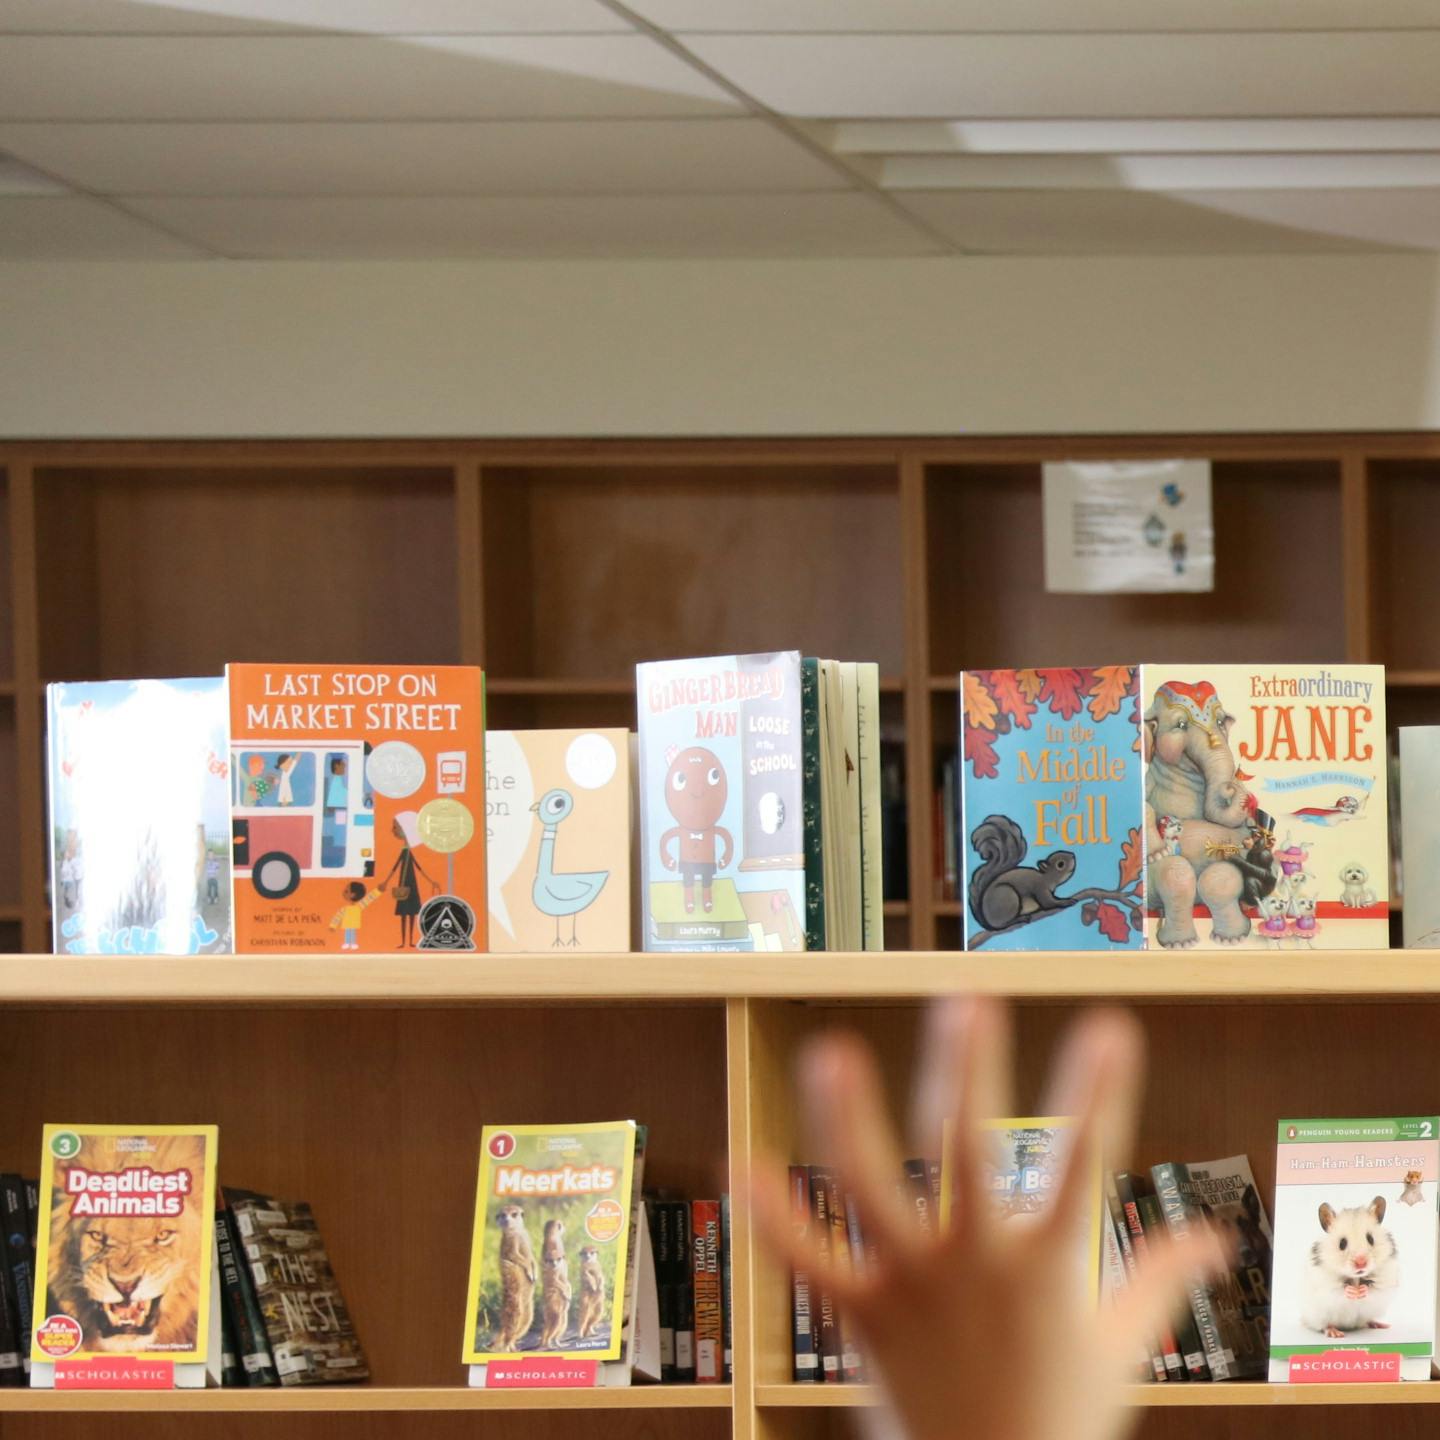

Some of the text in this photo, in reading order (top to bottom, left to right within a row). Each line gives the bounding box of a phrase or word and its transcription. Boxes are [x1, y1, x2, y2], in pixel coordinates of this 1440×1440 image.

[264, 673, 437, 697] LAST STOP ON
[649, 666, 784, 714] GINGERBREAD
[1250, 672, 1373, 703] Extraordinary
[247, 703, 461, 731] MARKET STREET
[695, 710, 737, 738] MAN
[750, 716, 791, 735] LOOSE
[1045, 724, 1095, 745] In the
[1240, 705, 1373, 762] JANE
[750, 754, 796, 776] SCHOOL
[1016, 748, 1126, 784] Middle
[1062, 784, 1081, 805] of
[1034, 797, 1112, 847] Fall
[1420, 1121, 1432, 1137] 2
[60, 1139, 70, 1153] 3
[496, 1140, 505, 1154] 1
[69, 1170, 187, 1192] Deadliest
[498, 1167, 613, 1192] Meerkats
[73, 1193, 180, 1214] Animals
[1161, 1186, 1184, 1223] WAR
[695, 1237, 705, 1272] OPPEL
[706, 1221, 718, 1273] KENNETH
[273, 1253, 316, 1283] THE
[280, 1292, 341, 1332] NEST
[67, 1370, 165, 1380] SCHOLASTIC
[506, 1370, 587, 1379] SCHOLASTIC
[1304, 1361, 1394, 1370] SCHOLASTIC
